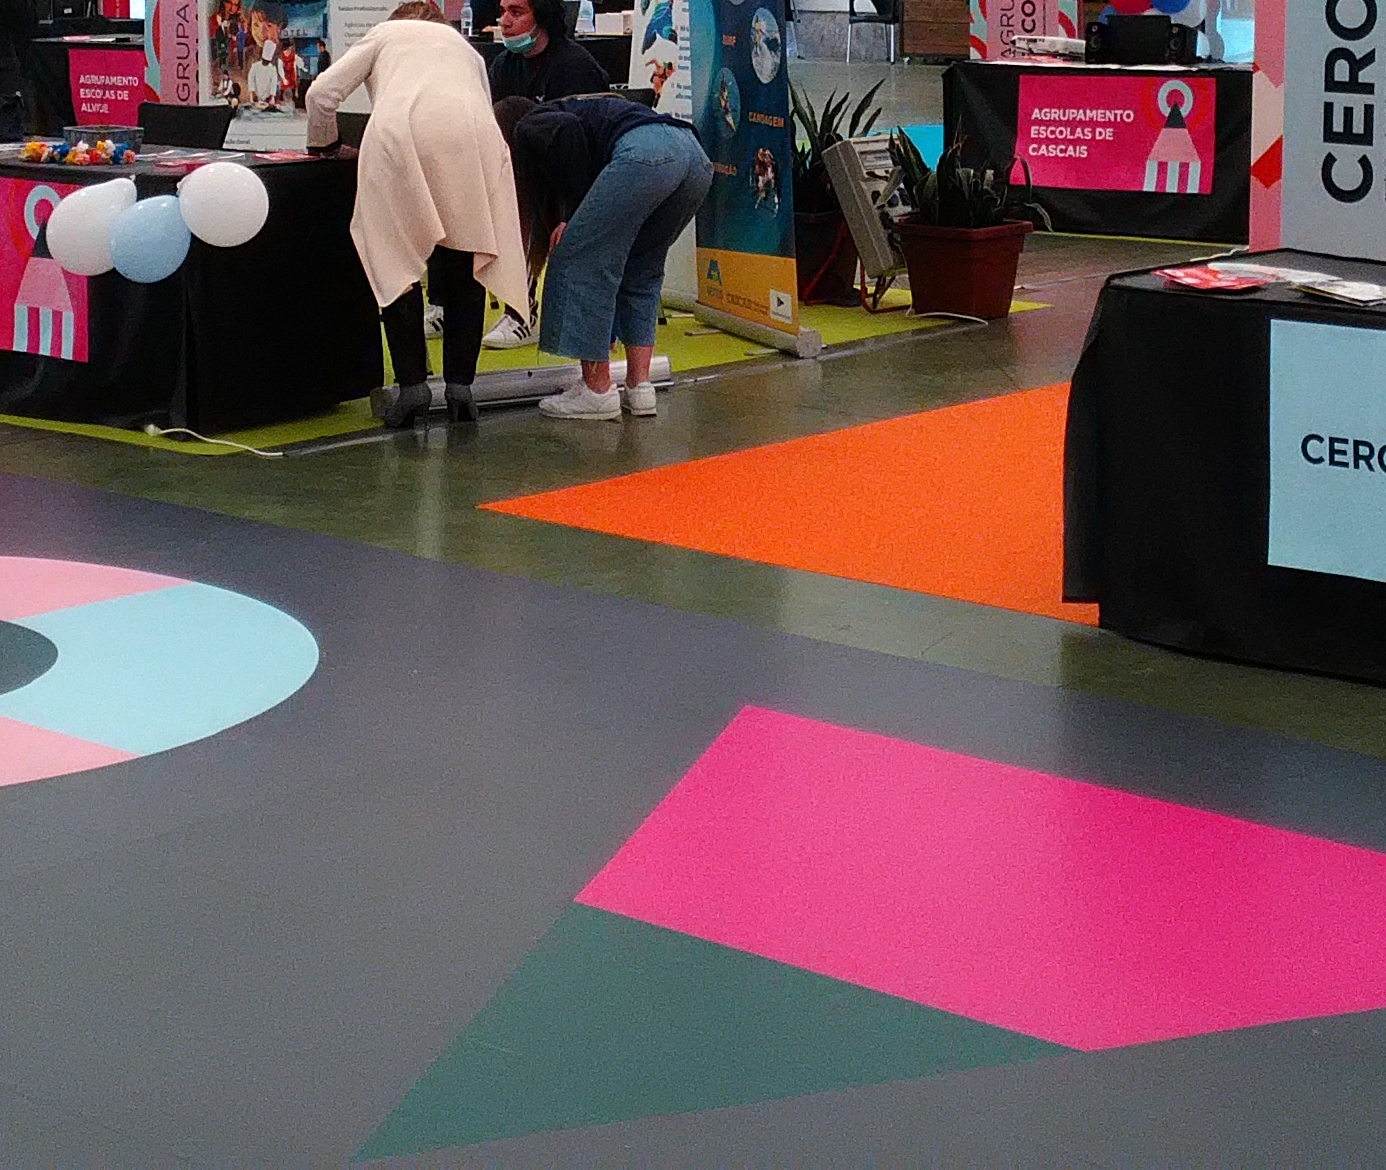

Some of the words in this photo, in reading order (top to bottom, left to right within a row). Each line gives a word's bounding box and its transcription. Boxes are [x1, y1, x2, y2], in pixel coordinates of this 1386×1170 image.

[79, 74, 139, 87] AGRUPAMENTO
[79, 88, 115, 100] ESCOLAS
[116, 90, 129, 101] DE
[1031, 108, 1135, 123] AGRUPAMENTO
[1030, 125, 1092, 140] ESCOLAS
[1095, 127, 1114, 141] DE
[1028, 143, 1088, 158] CASCAIS
